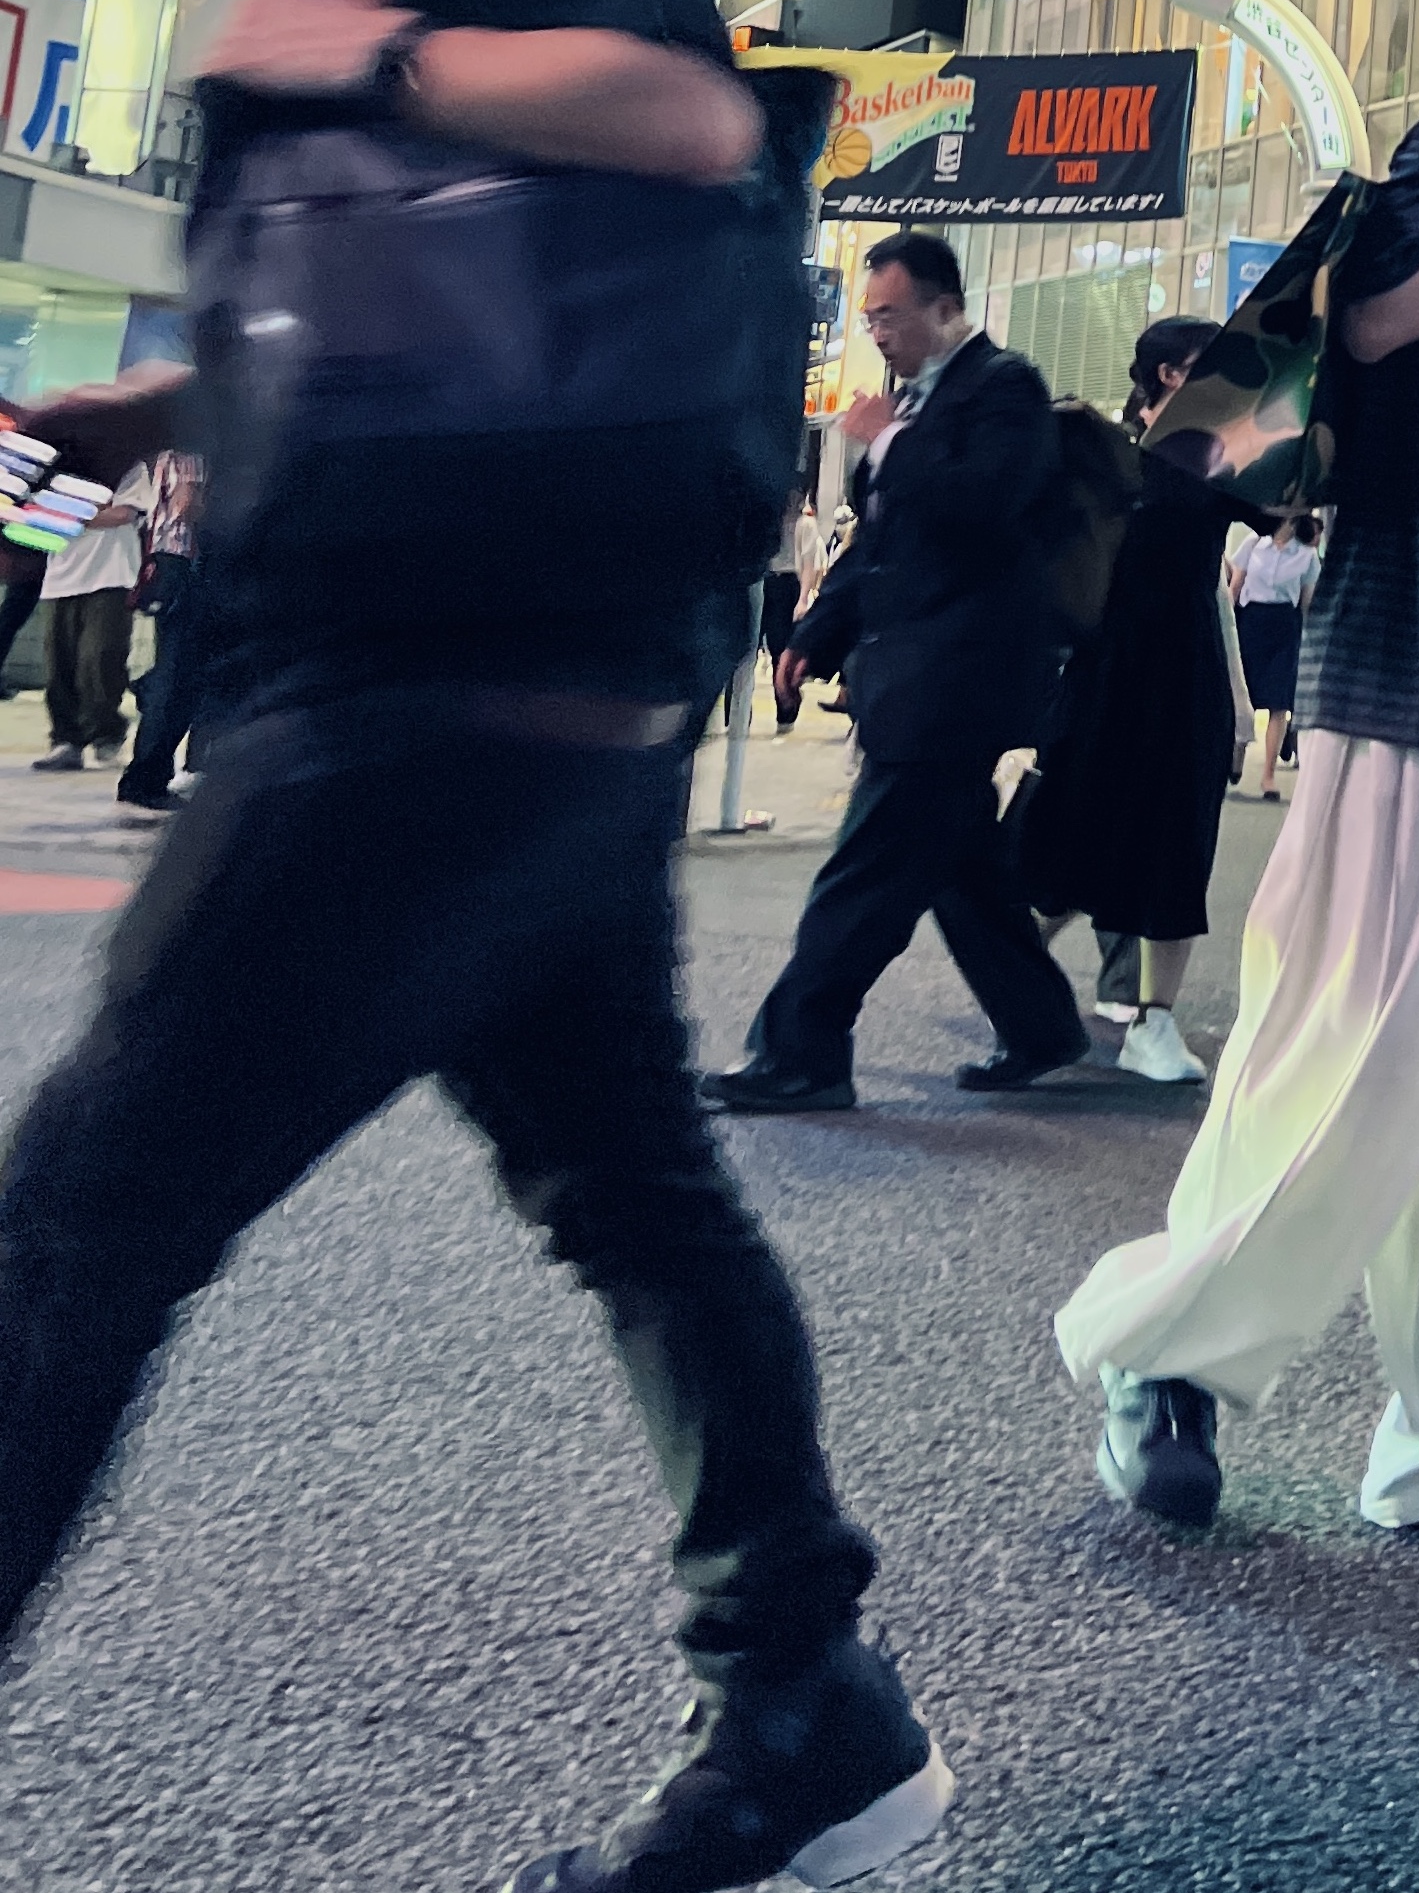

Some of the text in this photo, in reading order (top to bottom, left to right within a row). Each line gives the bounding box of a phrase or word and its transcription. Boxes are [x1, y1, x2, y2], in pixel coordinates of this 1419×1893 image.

[828, 73, 972, 130] Basketball
[1007, 85, 1158, 155] ALVARK
[1056, 159, 1098, 184] TOKYO
